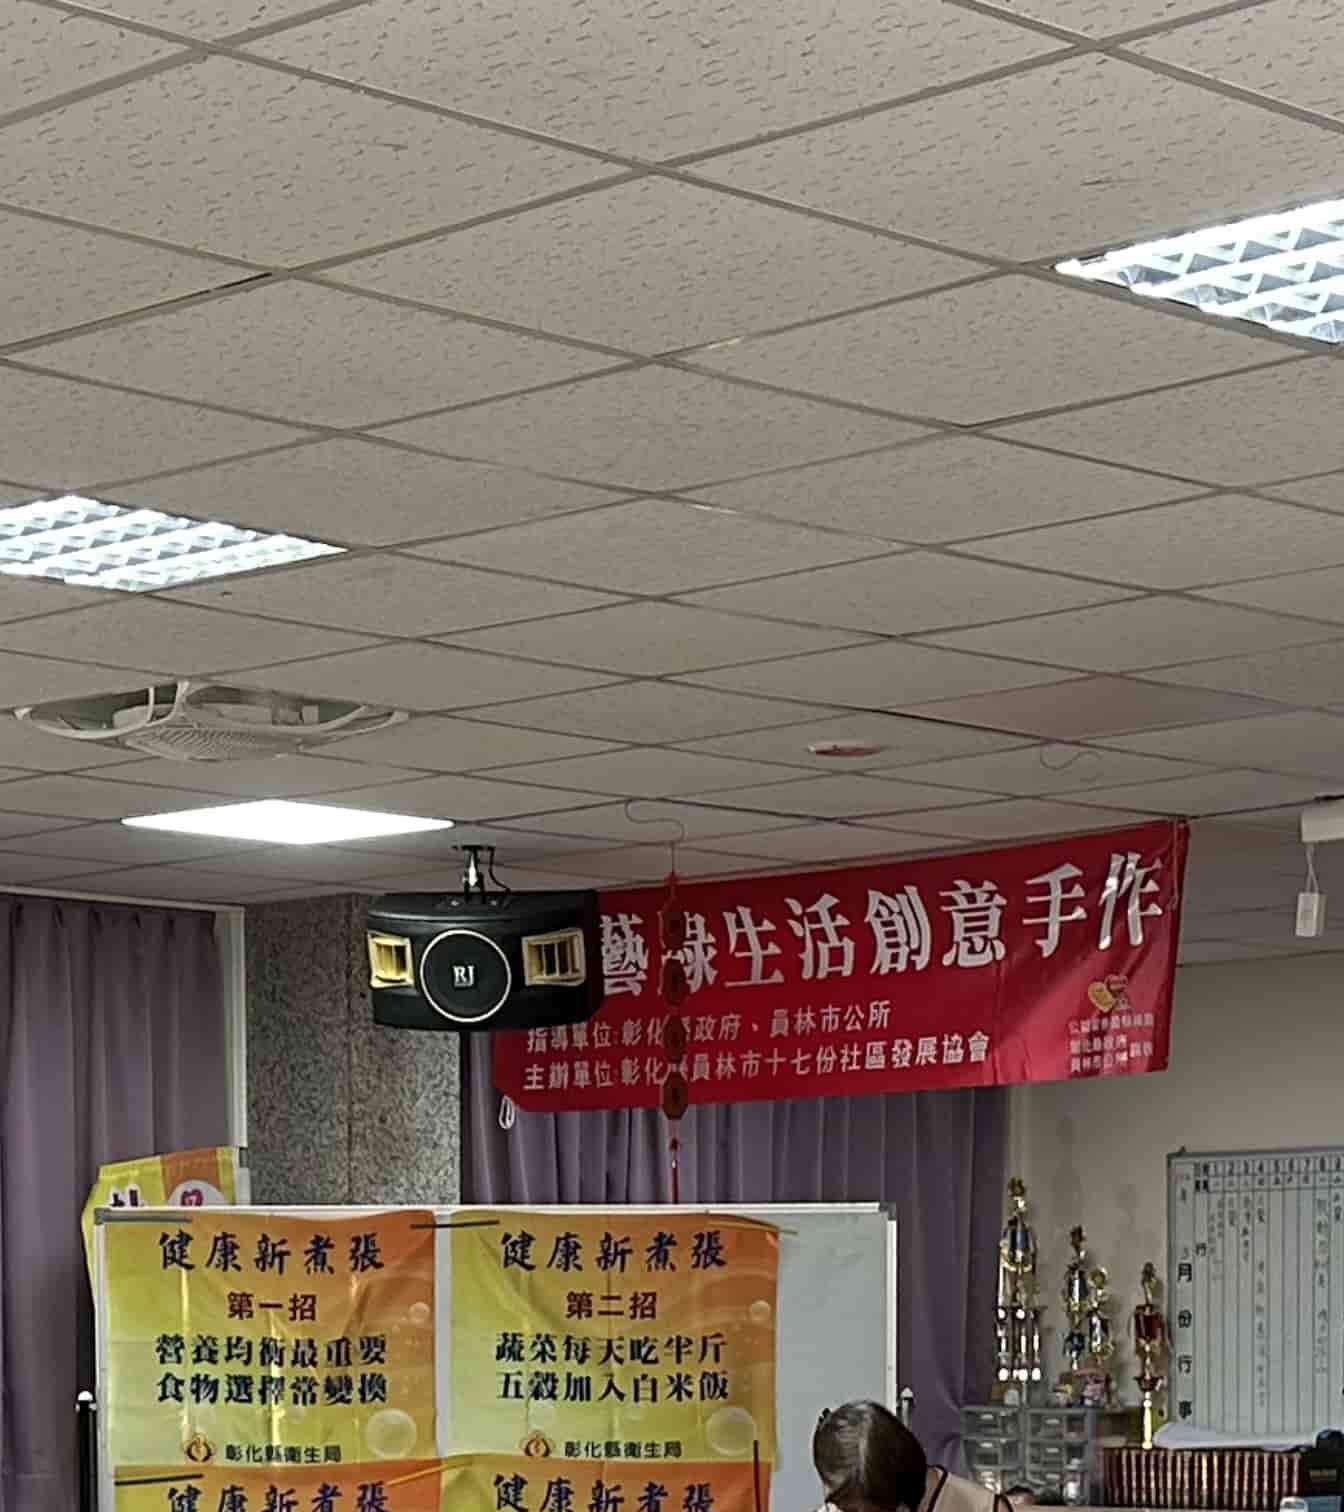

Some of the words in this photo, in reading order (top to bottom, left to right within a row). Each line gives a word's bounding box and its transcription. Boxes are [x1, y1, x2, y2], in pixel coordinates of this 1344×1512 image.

[158, 1230, 385, 1274] 健康新煮張
[501, 1230, 727, 1273] 健康新煮張
[227, 1291, 317, 1321] 第一招
[565, 1291, 657, 1320] 第二招
[156, 1333, 387, 1369] 營養均衡最重要
[496, 1332, 728, 1365] 蔬菜每天吃半斤
[157, 1371, 388, 1406] 食物選擇常變換
[496, 1370, 729, 1403] 五穀加入白米飯
[225, 1444, 343, 1464] 彰化縣衛生局
[564, 1440, 683, 1459] 彰化縣衛生局
